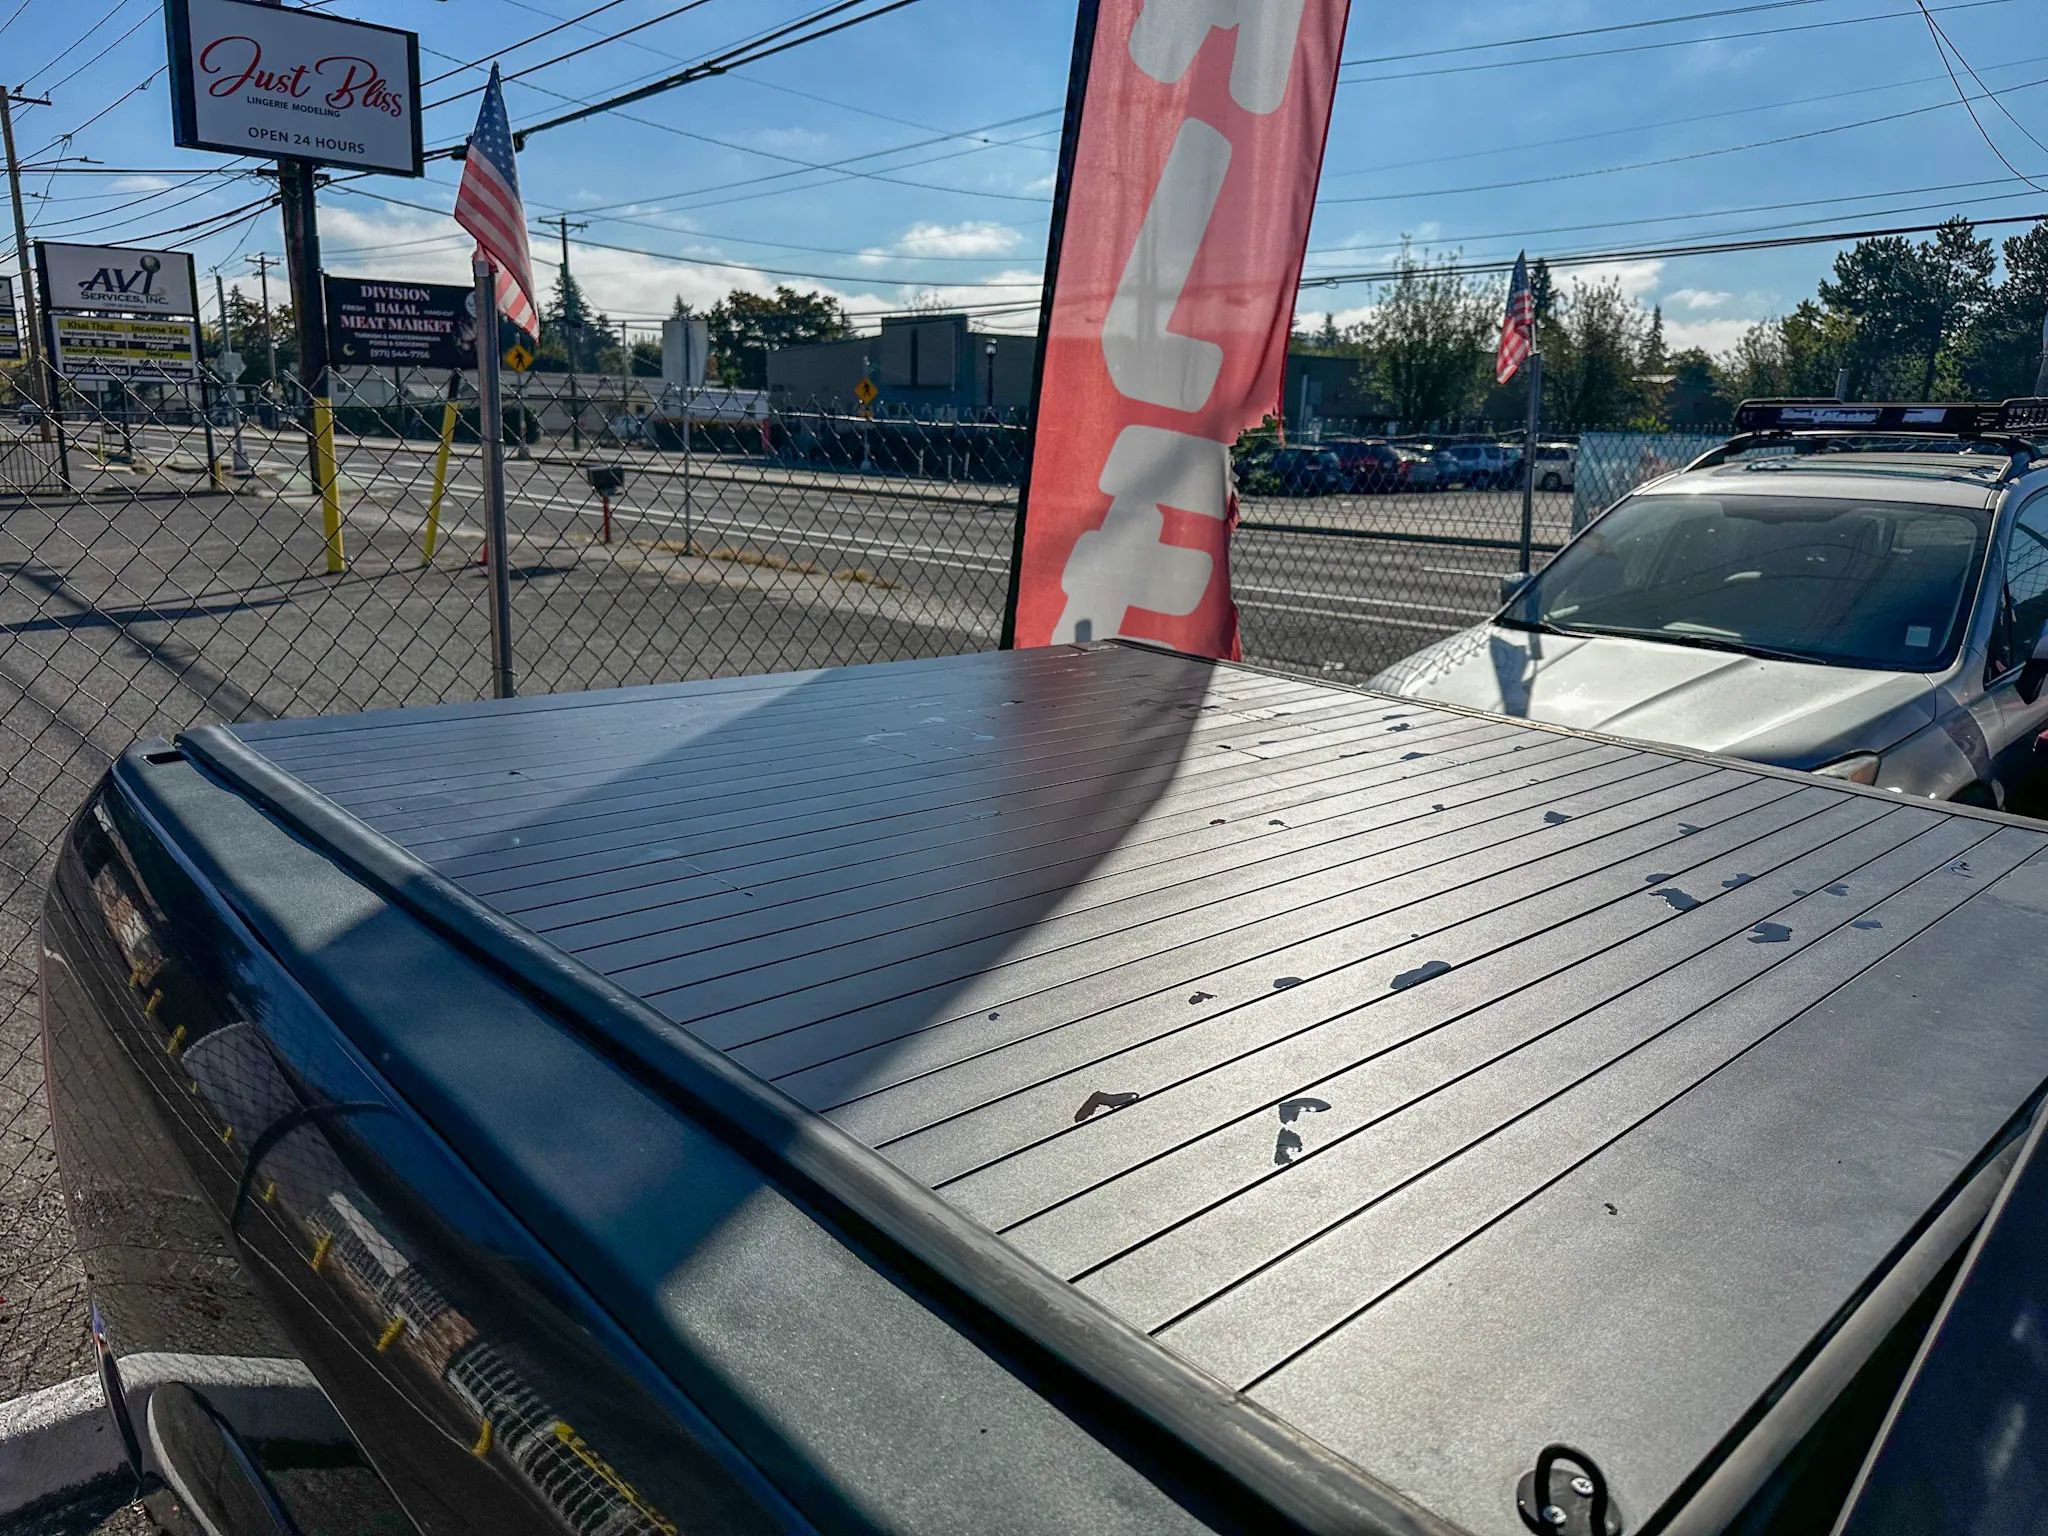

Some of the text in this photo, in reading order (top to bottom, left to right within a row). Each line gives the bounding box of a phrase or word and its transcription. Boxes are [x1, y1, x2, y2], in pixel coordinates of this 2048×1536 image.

[200, 36, 402, 117] Just Bliss
[247, 95, 341, 118] LINGERIE MODELING
[248, 126, 365, 154] OPEN 24 HOURS
[360, 285, 430, 301] DIVISION
[342, 304, 366, 312] FRESH
[375, 302, 420, 316] HALAL
[340, 315, 453, 333] MEAT MARKET
